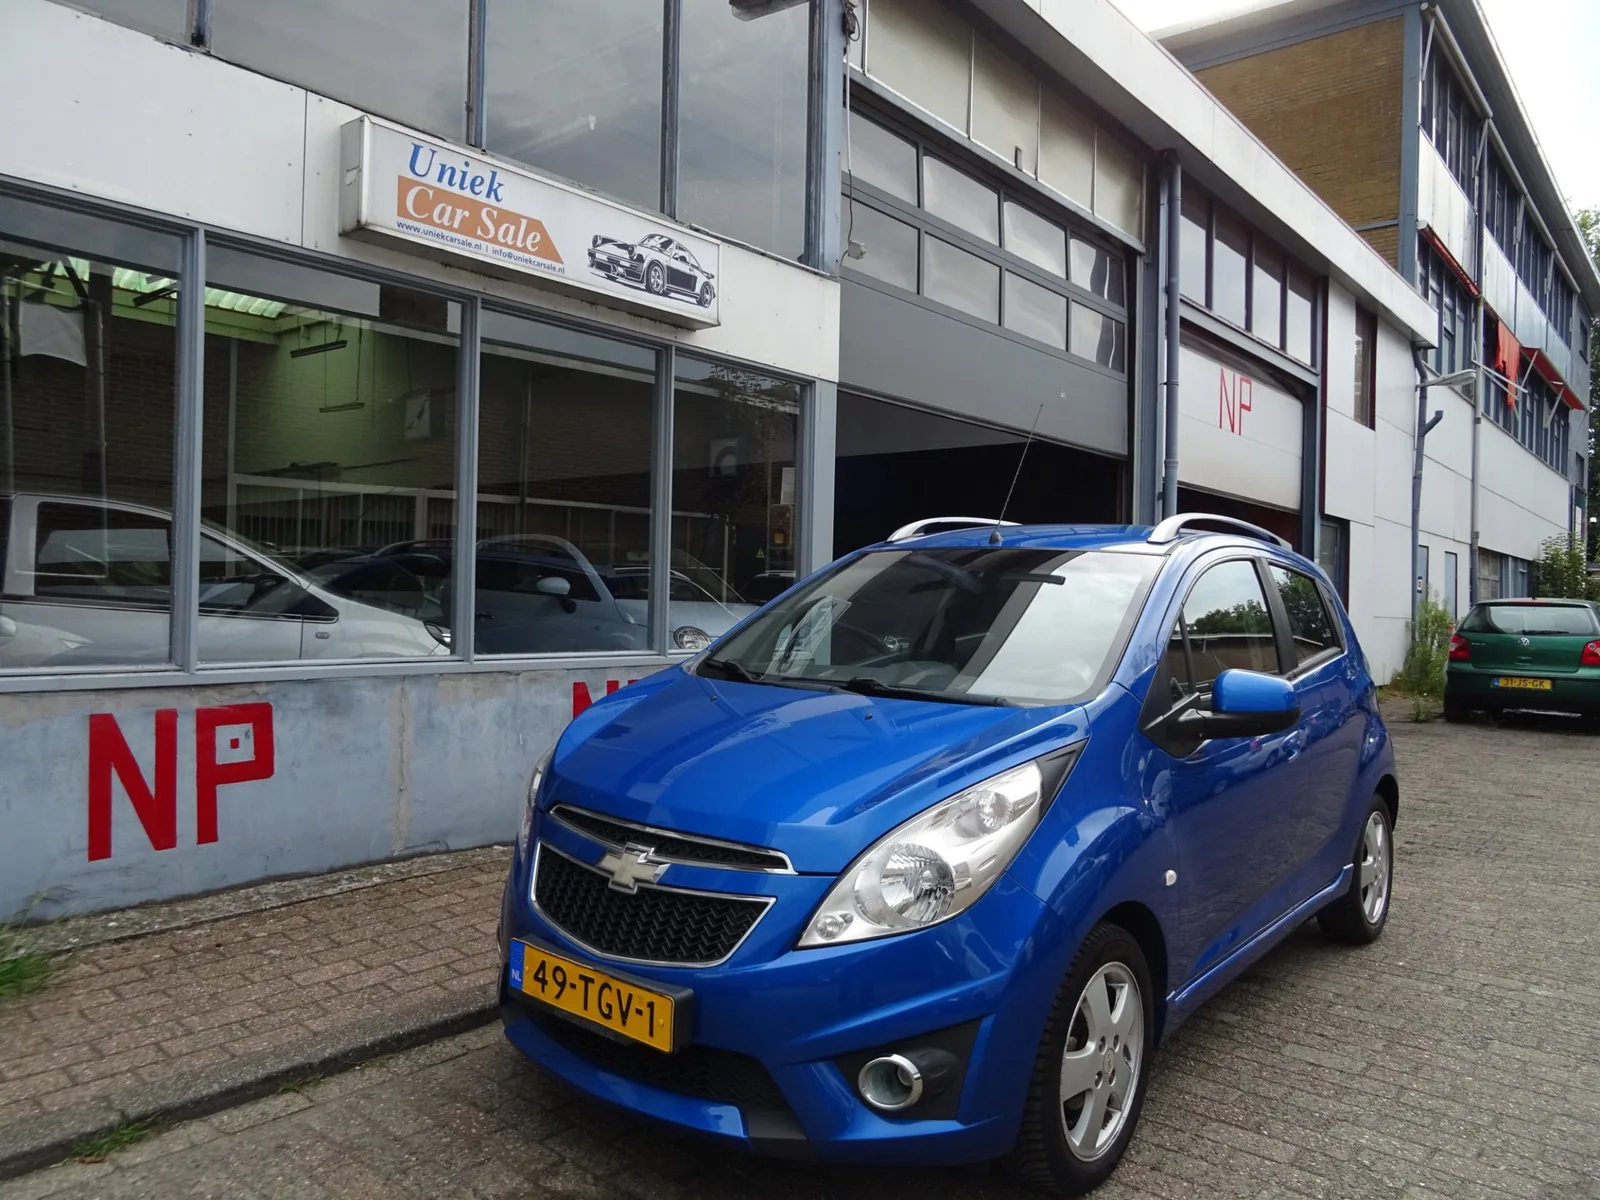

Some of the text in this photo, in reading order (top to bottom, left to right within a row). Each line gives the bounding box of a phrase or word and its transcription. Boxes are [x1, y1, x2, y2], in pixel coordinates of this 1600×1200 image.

[409, 142, 505, 203] Uniek
[396, 220, 566, 274] www.uniekcarsale.nl info@uniekcarsale.nl
[405, 185, 541, 252] Car Sale
[1219, 366, 1253, 436] NP
[87, 701, 275, 862] NP
[511, 968, 522, 982] NL
[533, 960, 655, 1038] 49-TGV-1
